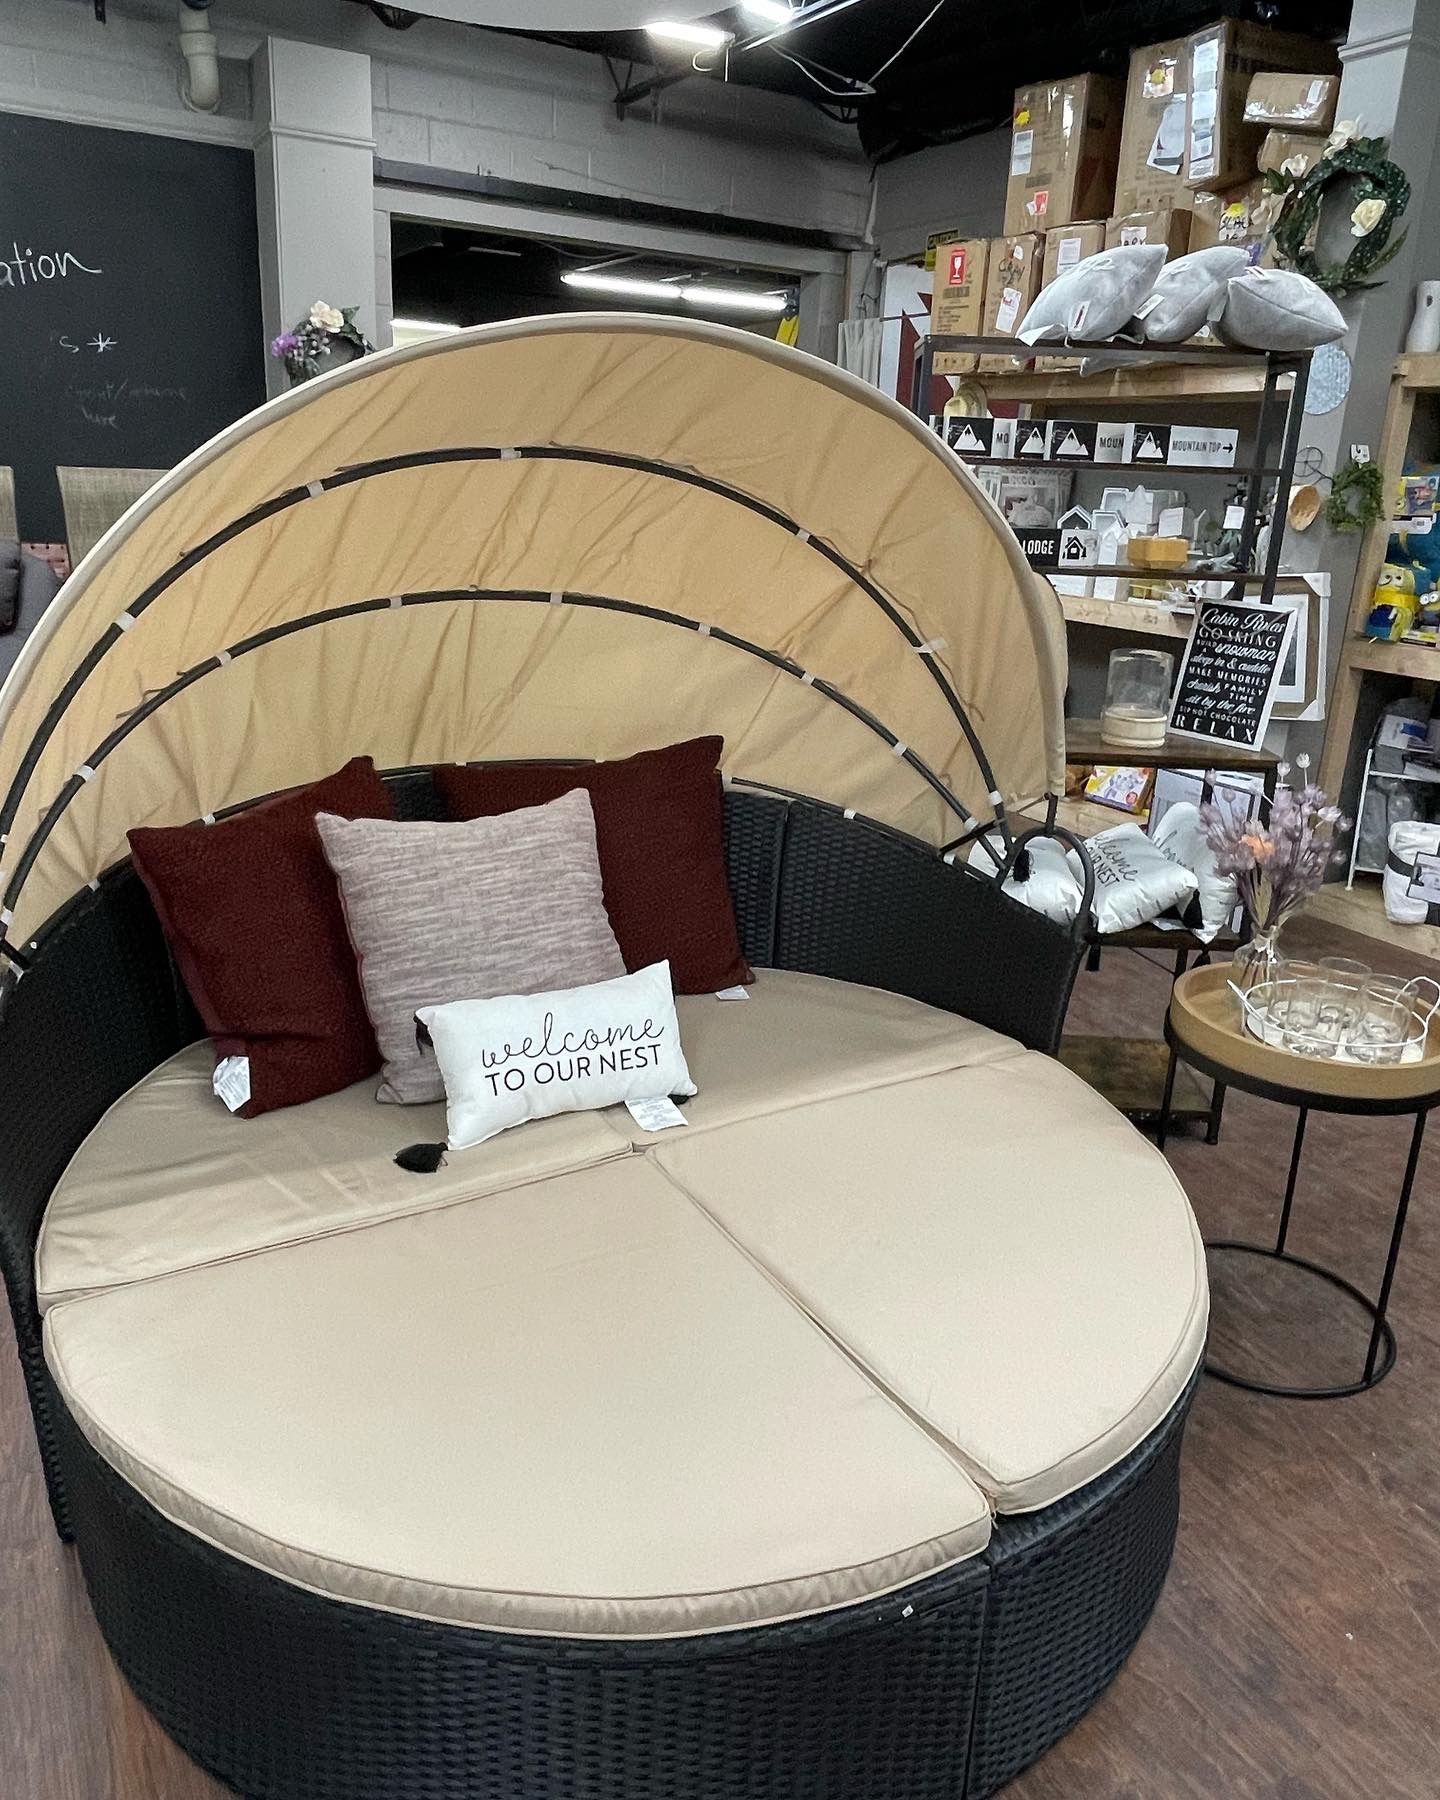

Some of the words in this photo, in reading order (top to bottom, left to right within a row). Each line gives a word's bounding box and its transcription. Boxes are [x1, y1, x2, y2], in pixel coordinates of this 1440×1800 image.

[1171, 440, 1208, 453] MOUNTAIN
[1208, 441, 1222, 454] TOP
[1200, 608, 1239, 626] Cabin
[1189, 666, 1211, 676] MAKE
[1217, 670, 1266, 687] MEMORIES
[1223, 682, 1263, 696] FAMILY
[1229, 692, 1253, 703] TIME
[1175, 714, 1254, 742] RELAX
[1210, 711, 1256, 727] CHOCOLATE
[482, 1012, 664, 1068] welcome
[485, 1069, 525, 1096] TO
[534, 1057, 591, 1085] OUR
[600, 1044, 661, 1075] NEST
